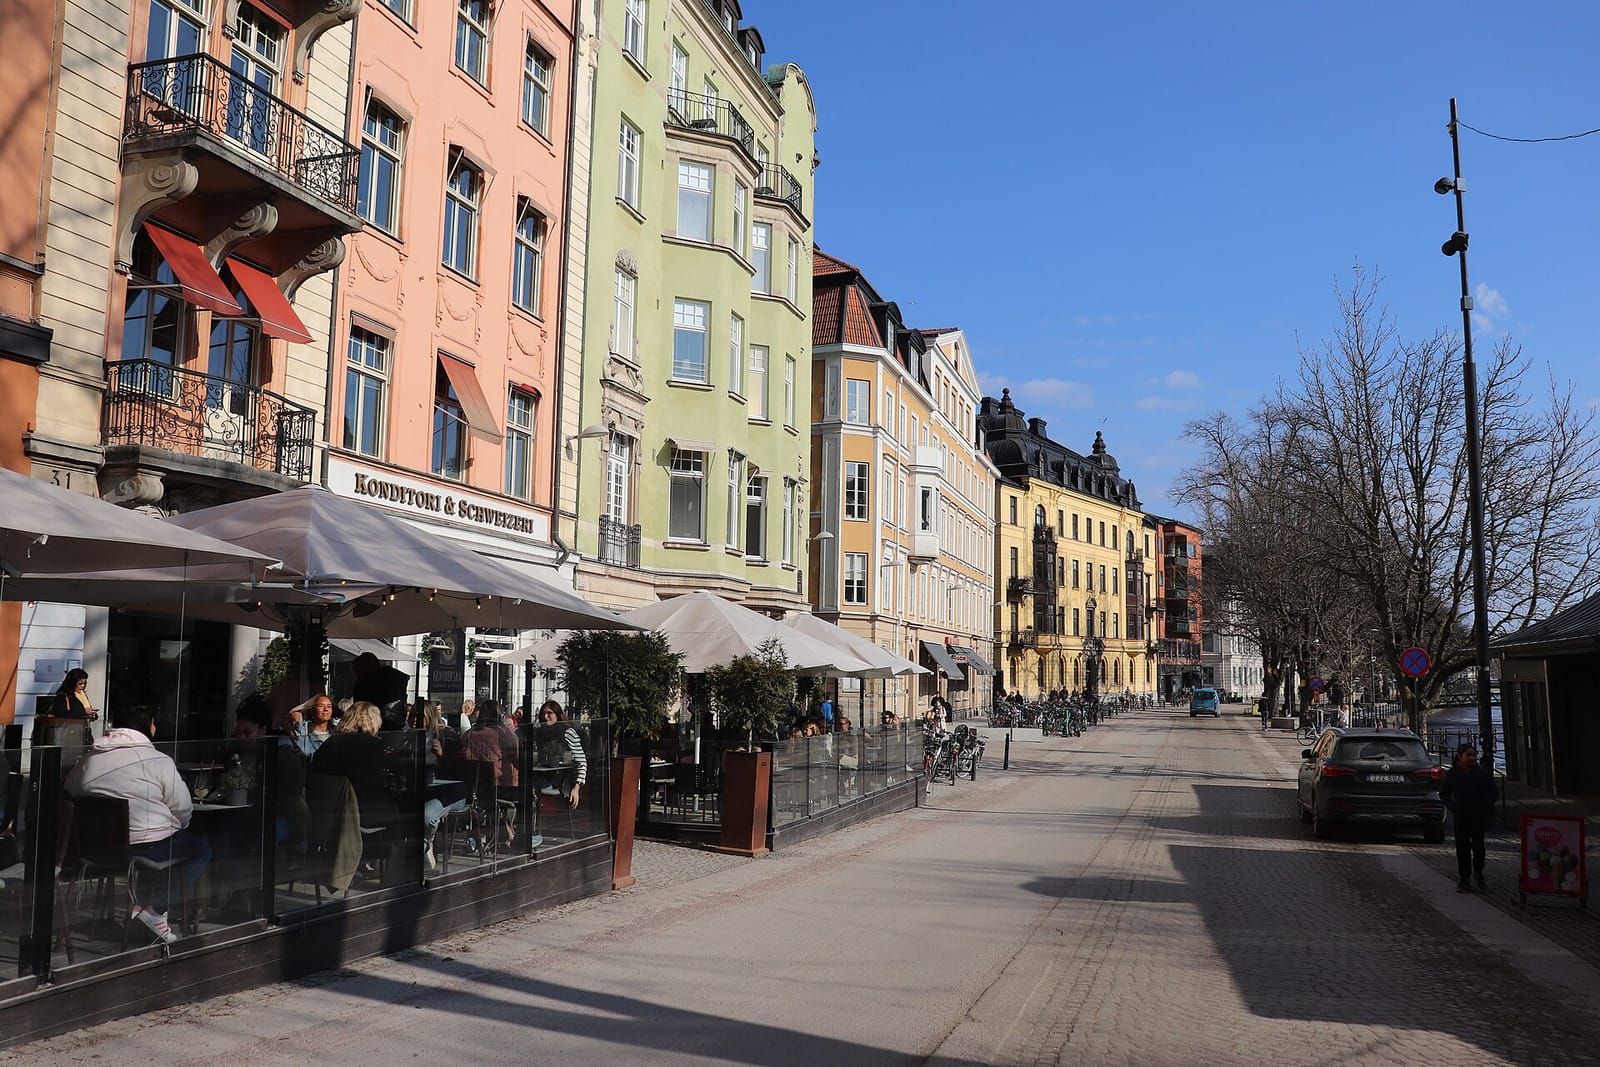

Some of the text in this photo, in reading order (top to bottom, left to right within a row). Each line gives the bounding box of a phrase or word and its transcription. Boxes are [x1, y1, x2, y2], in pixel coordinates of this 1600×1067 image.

[50, 470, 71, 489] 31
[354, 472, 535, 534] KONDITORI & SCHWEIZERI
